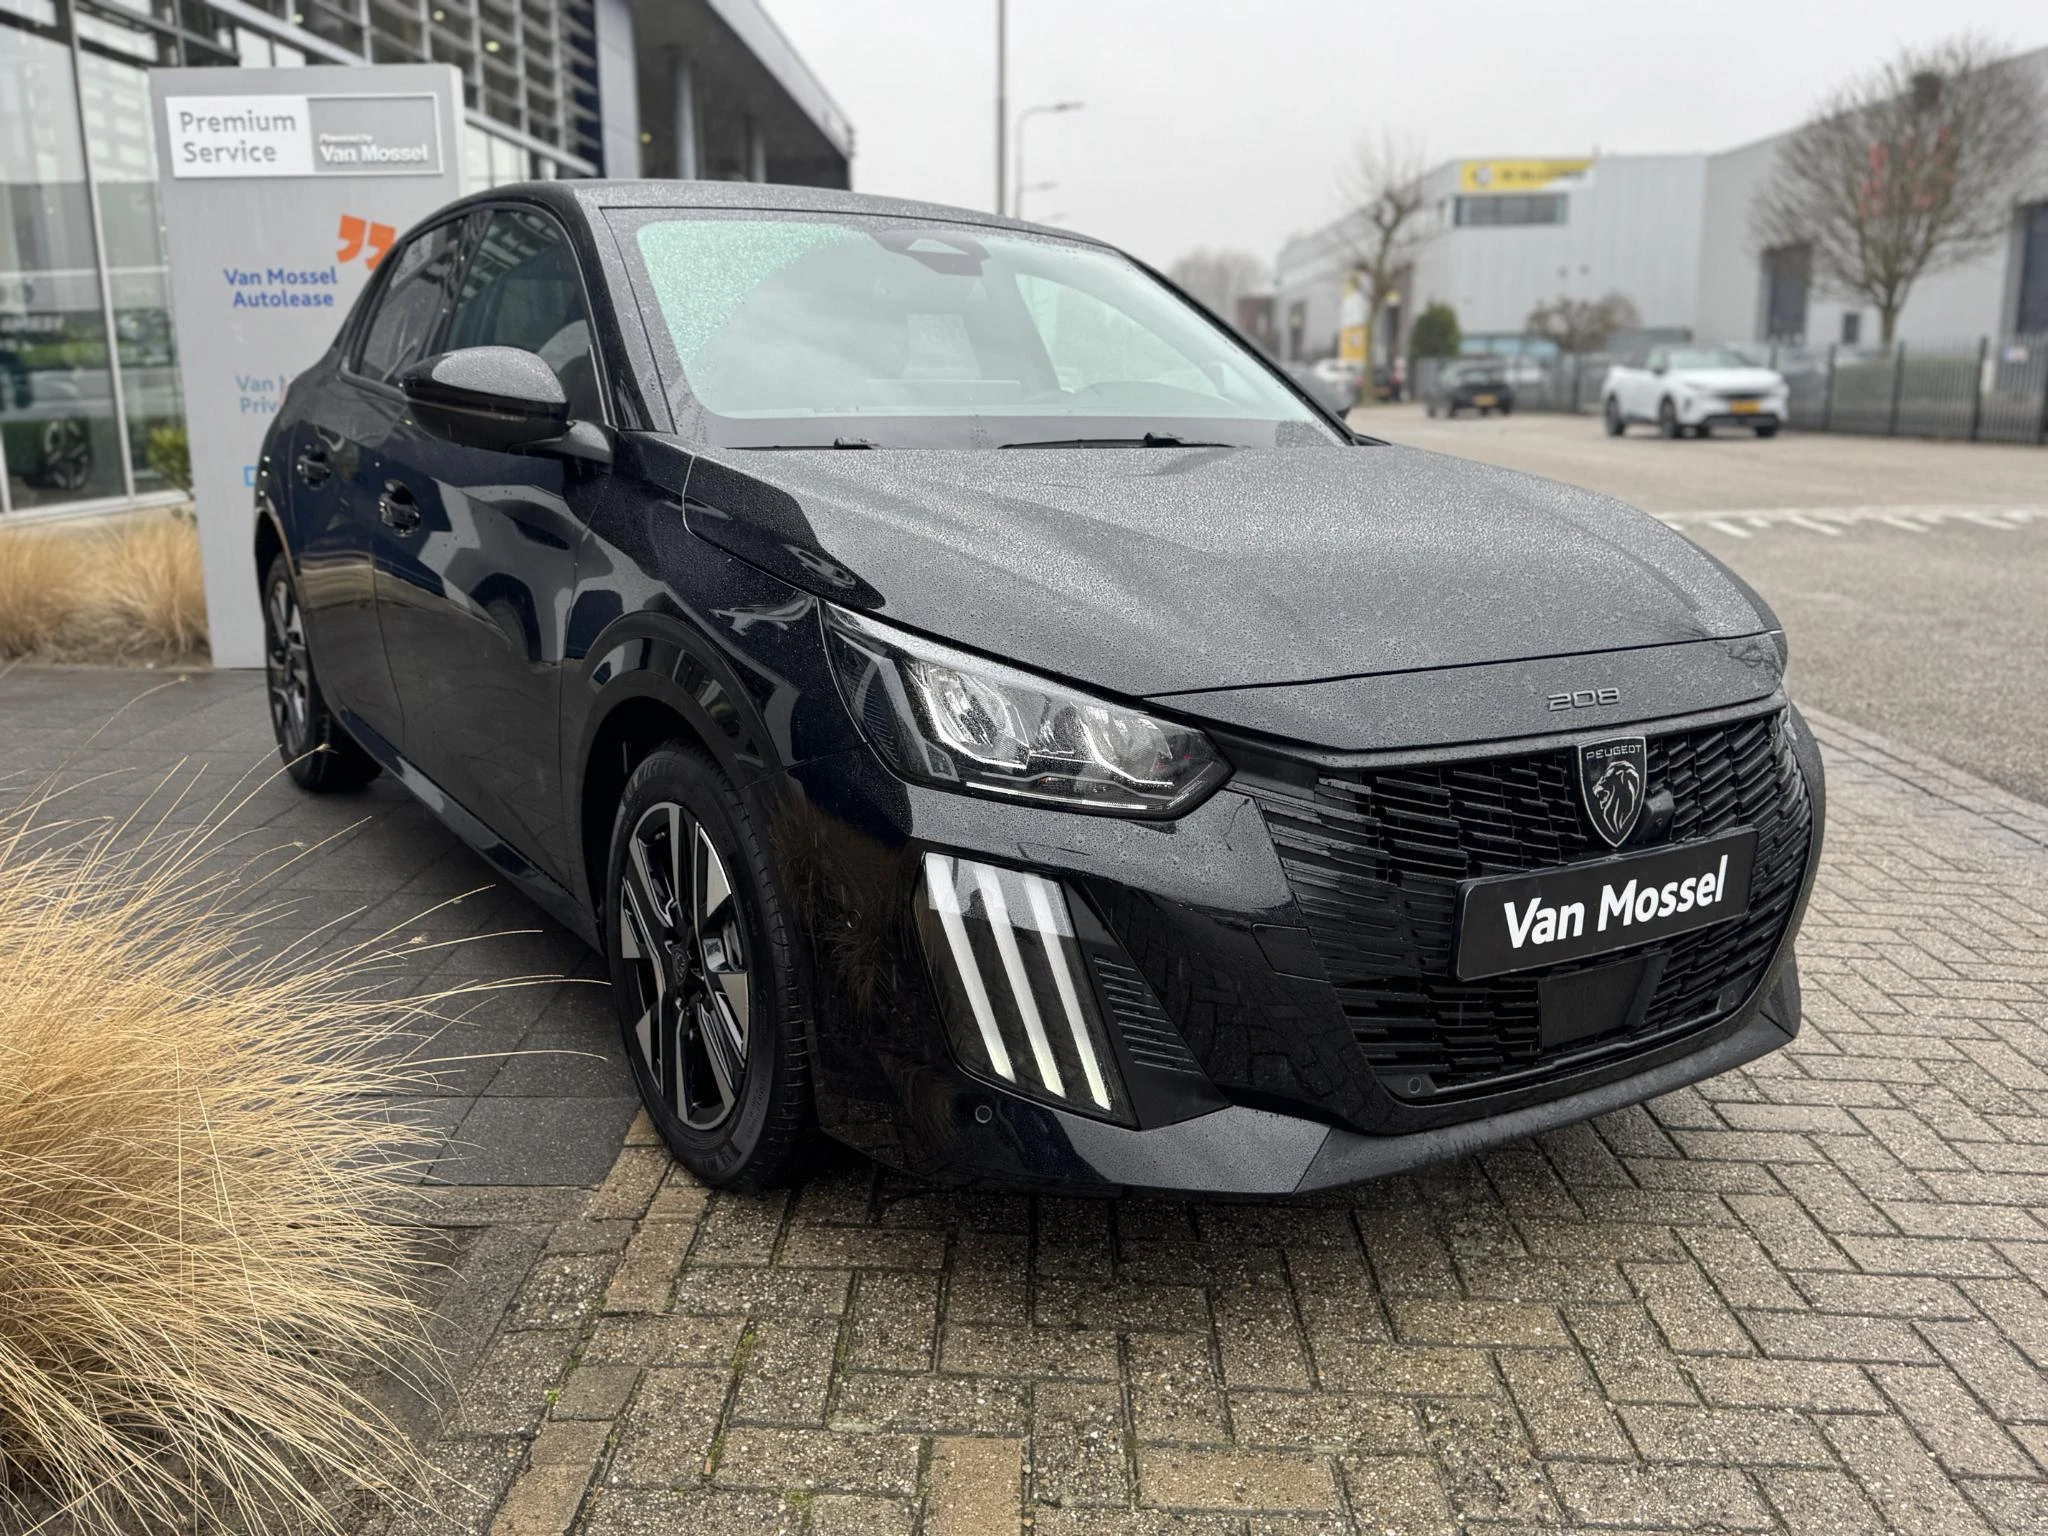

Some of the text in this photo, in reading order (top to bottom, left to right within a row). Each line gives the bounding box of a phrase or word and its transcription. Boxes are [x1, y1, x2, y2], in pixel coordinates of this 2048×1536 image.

[179, 110, 296, 133] Premium
[183, 139, 277, 163] Service
[320, 143, 428, 162] Van Mossel
[223, 266, 338, 285] Van Mossel
[233, 289, 334, 308] Autolease
[235, 375, 274, 392] Van
[1547, 687, 1619, 712] 208
[1586, 744, 1642, 760] PEUGEOT
[1503, 854, 1729, 949] Van Mossel
